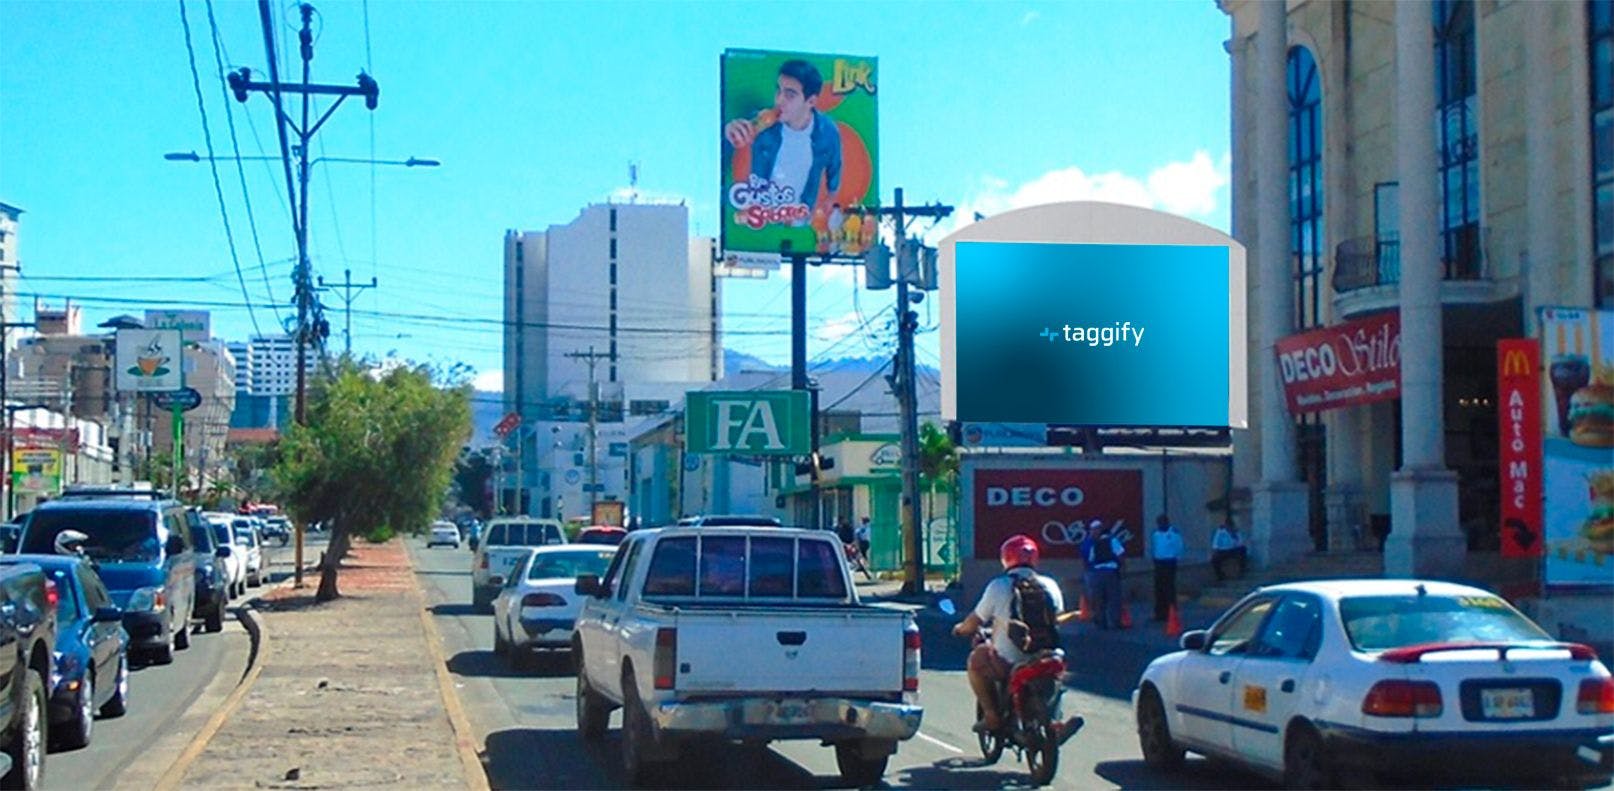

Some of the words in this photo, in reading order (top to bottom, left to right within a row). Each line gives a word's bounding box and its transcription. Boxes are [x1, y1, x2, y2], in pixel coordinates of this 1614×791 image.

[729, 183, 795, 210] Gustos
[1062, 321, 1145, 347] taggify
[1279, 342, 1337, 383] DECO
[711, 400, 786, 450] FA
[1509, 390, 1525, 451] Auto
[986, 486, 1085, 506] DECO
[1510, 461, 1528, 509] Mac
